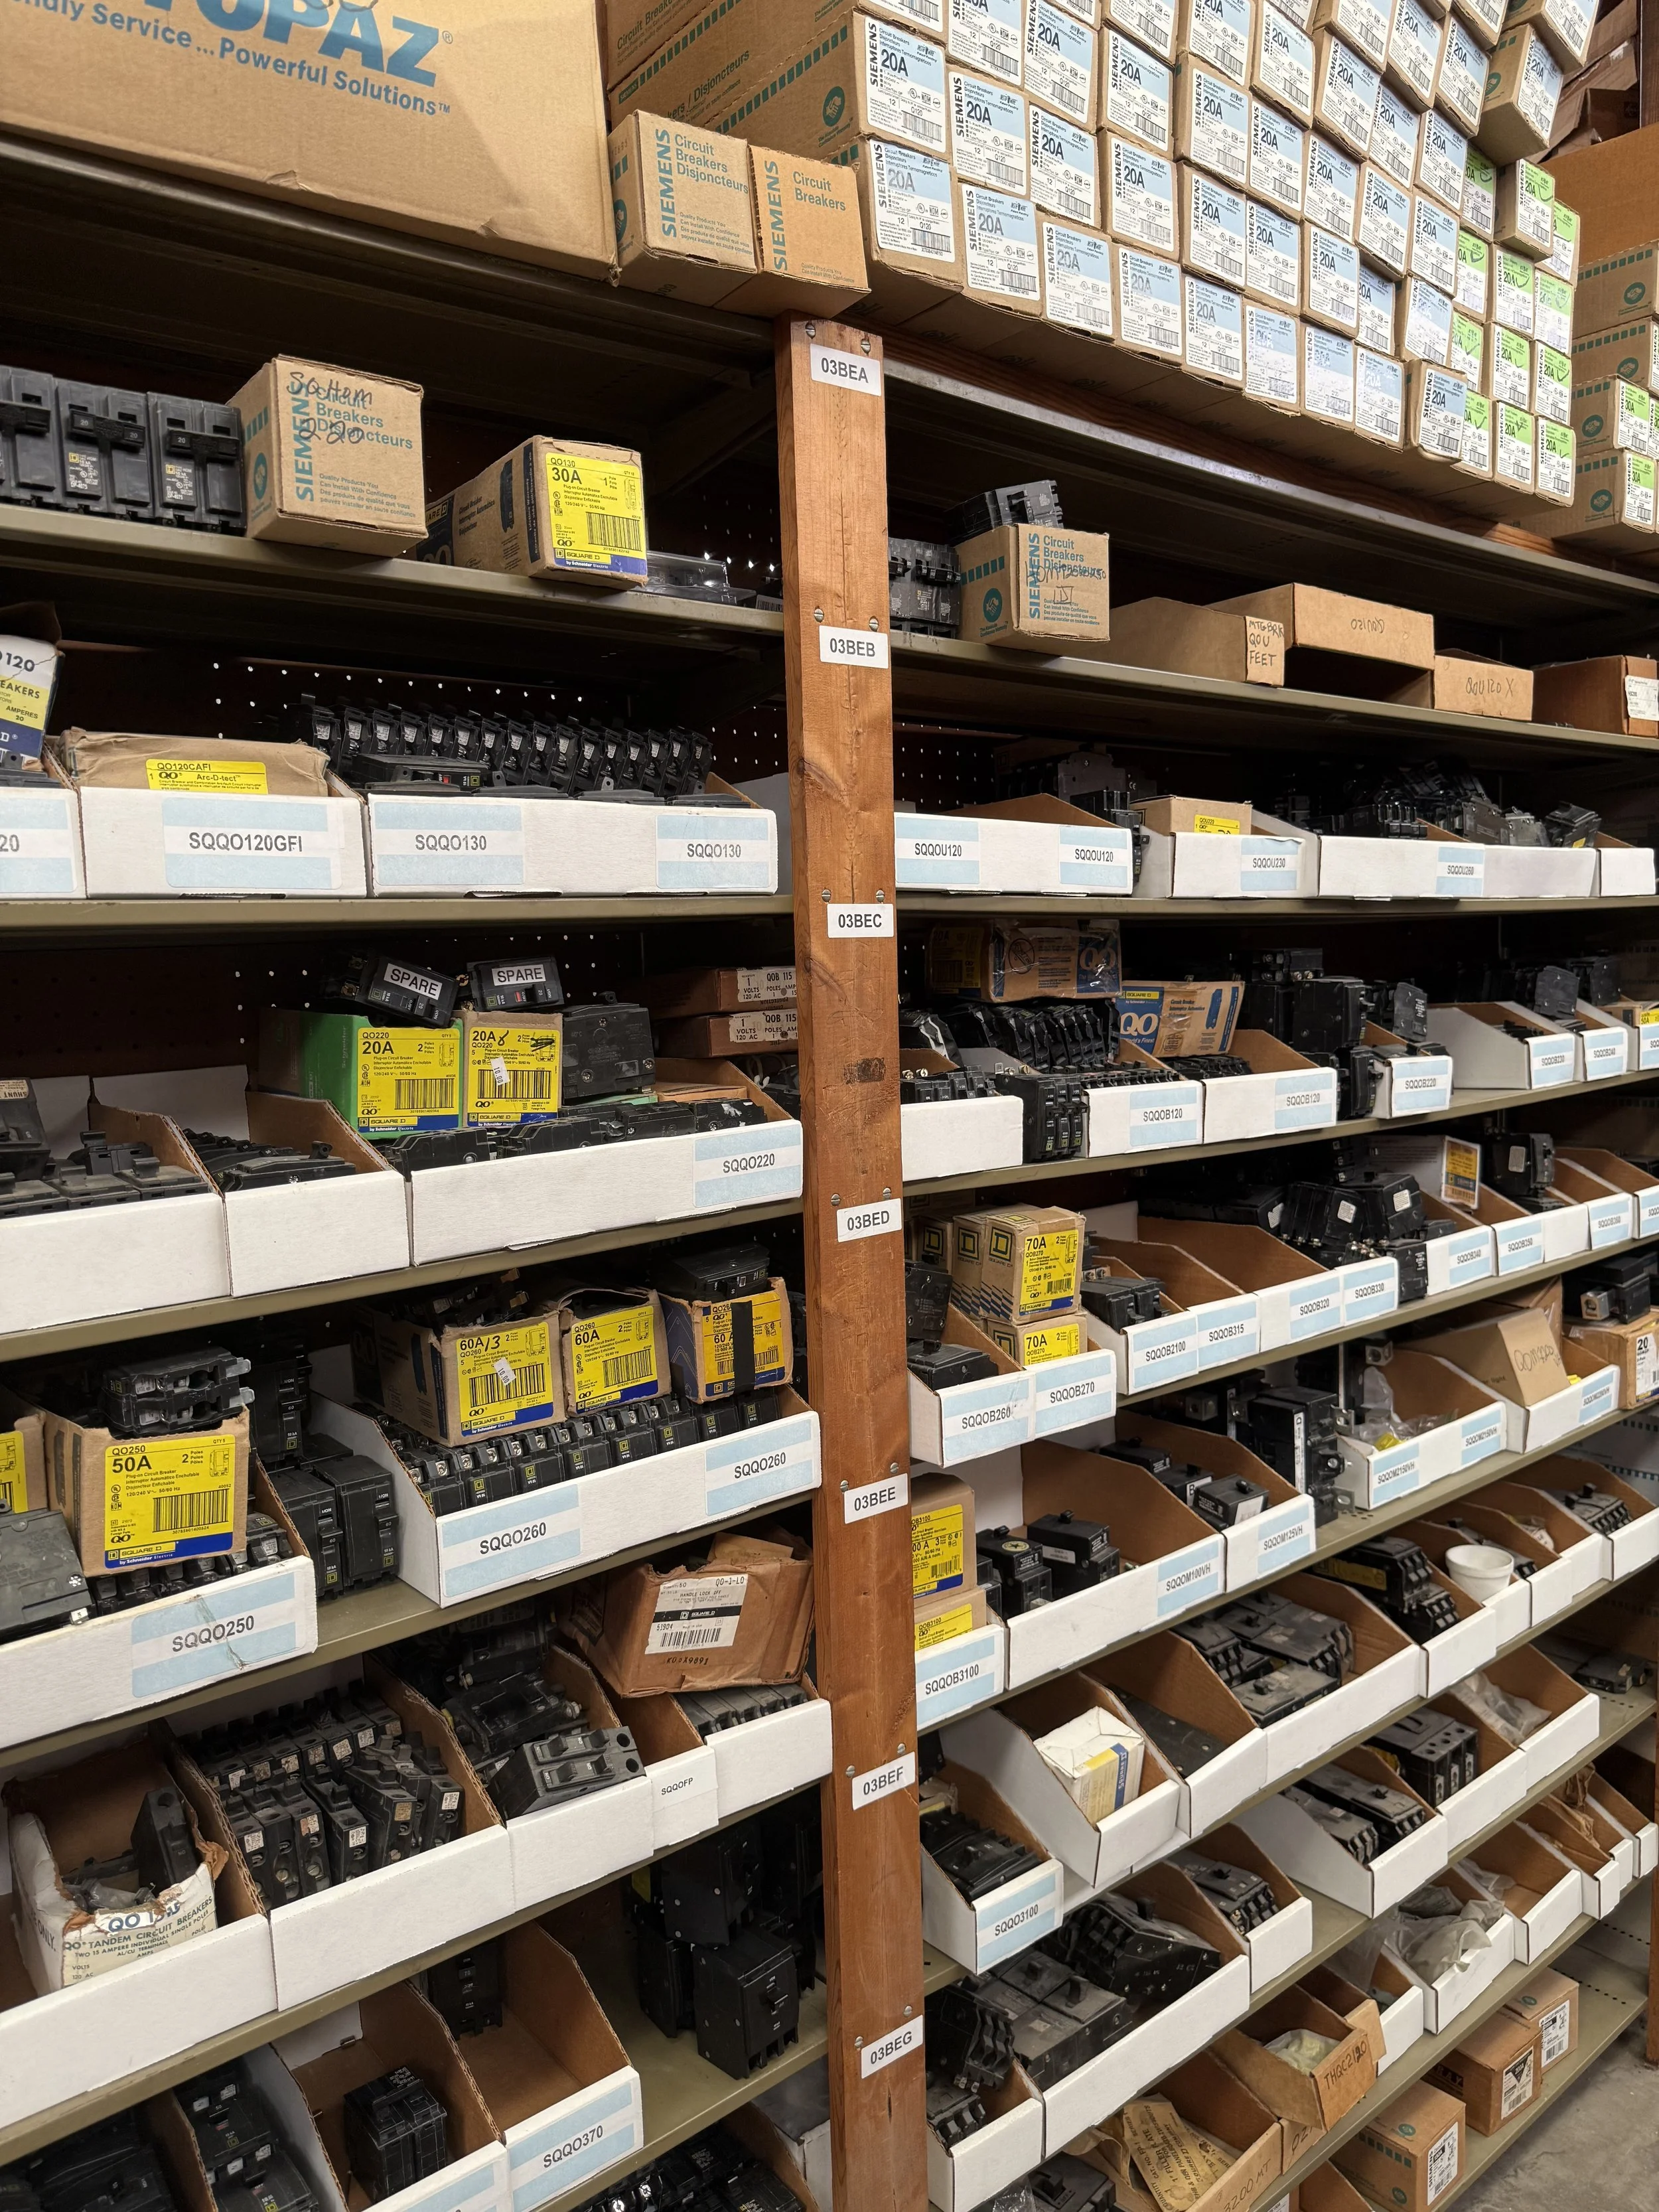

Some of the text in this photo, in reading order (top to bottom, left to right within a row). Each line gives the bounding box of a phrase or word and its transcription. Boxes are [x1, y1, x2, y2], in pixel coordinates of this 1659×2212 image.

[92, 4, 192, 48] Service
[869, 23, 879, 87] SIEMENS
[881, 49, 908, 77] 20A
[910, 108, 922, 116] Q120
[954, 78, 964, 137] SIEMENS
[966, 102, 991, 126] 20A
[1203, 96, 1224, 119] 20A
[675, 134, 714, 156] Circuit
[676, 149, 727, 173] Breakers
[656, 129, 677, 238] SIEMENS
[677, 163, 749, 194] Disjoncteurs
[793, 171, 831, 192] Circuit
[874, 144, 887, 208] SIEMENS
[888, 169, 916, 192] 20A
[794, 188, 845, 210] Breakers
[764, 161, 787, 271] SIEMENS
[966, 190, 977, 251] SIEMENS
[978, 214, 1004, 236] 20A
[821, 357, 869, 384] 03BEA
[316, 402, 384, 427] Breakers
[290, 381, 314, 502] SIEMENS
[317, 417, 413, 449] Disjoncteurs
[551, 457, 575, 468] QO130
[552, 467, 582, 485] 30A
[1044, 536, 1074, 550] Circuit
[1044, 547, 1084, 562] Breakers
[1029, 533, 1040, 619] SIEMENS
[829, 637, 875, 658] 03BEB
[1250, 651, 1277, 666] FEET
[6, 705, 38, 719] AMPERES
[157, 762, 211, 771] QO120CAFI
[188, 832, 303, 853] SQQO120GFI
[415, 834, 487, 852] SQQO130
[687, 843, 741, 859] SQQO130
[914, 842, 962, 858] SQQOU120
[1074, 848, 1114, 863] SQQOU120
[1252, 857, 1286, 869] SQQOU230
[837, 913, 883, 929] 03BEC
[390, 968, 439, 996] SPARE
[497, 968, 543, 982] SPARE
[765, 1014, 781, 1023] QOB
[1121, 1012, 1158, 1036] QO
[472, 1031, 496, 1042] 20A
[362, 1041, 394, 1055] 20A
[1404, 1078, 1436, 1090] SQQOB220
[1286, 1092, 1321, 1106] SQQOB120
[1143, 1108, 1183, 1122] SQQOB120
[723, 1153, 775, 1173] SQQO220
[847, 1211, 889, 1230] 03BED
[1026, 1238, 1046, 1251] 70A
[1354, 1282, 1385, 1300] SQQOB330
[1299, 1297, 1330, 1317] SQQOB320
[575, 1322, 595, 1333] QO260
[1208, 1323, 1244, 1342] SQQOB315
[459, 1339, 484, 1351] 60A
[575, 1331, 601, 1347] 60A
[1026, 1333, 1047, 1349] 70A
[1637, 1337, 1648, 1351] 20
[460, 1349, 482, 1358] QO260
[1026, 1347, 1045, 1356] QOB270
[1145, 1341, 1186, 1362] SQQOB2100
[1050, 1381, 1095, 1404] SQQOB270
[962, 1407, 1011, 1430] SQQOB260
[111, 1444, 146, 1455] QO250
[111, 1455, 153, 1474] 50A
[734, 1452, 786, 1479] SQQO260
[854, 1487, 896, 1512] 03BEE
[480, 1522, 547, 1555] SQQO260
[1263, 1525, 1303, 1550] SQQOM125VH
[121, 1546, 153, 1557] SQUARE
[126, 1556, 152, 1564] Schneider
[1166, 1563, 1210, 1591] SQQOM100VH
[172, 1615, 255, 1653] SQQO250
[925, 1664, 979, 1695] SQQOB3100
[661, 1777, 693, 1796] SQQOFP
[863, 1767, 904, 1795] 03BEF
[89, 1896, 212, 1949] TANDEM CIRCUIT BREAKERS
[995, 1903, 1039, 1937] SQQO3100
[102, 1945, 129, 1954] AMPERE
[131, 1935, 169, 1948] INDIVIDUAL
[171, 1922, 192, 1936] SINGLE
[139, 1940, 168, 1952] TERMINALS
[870, 2031, 912, 2065] 03BEG
[543, 2124, 604, 2170] SQQO370
